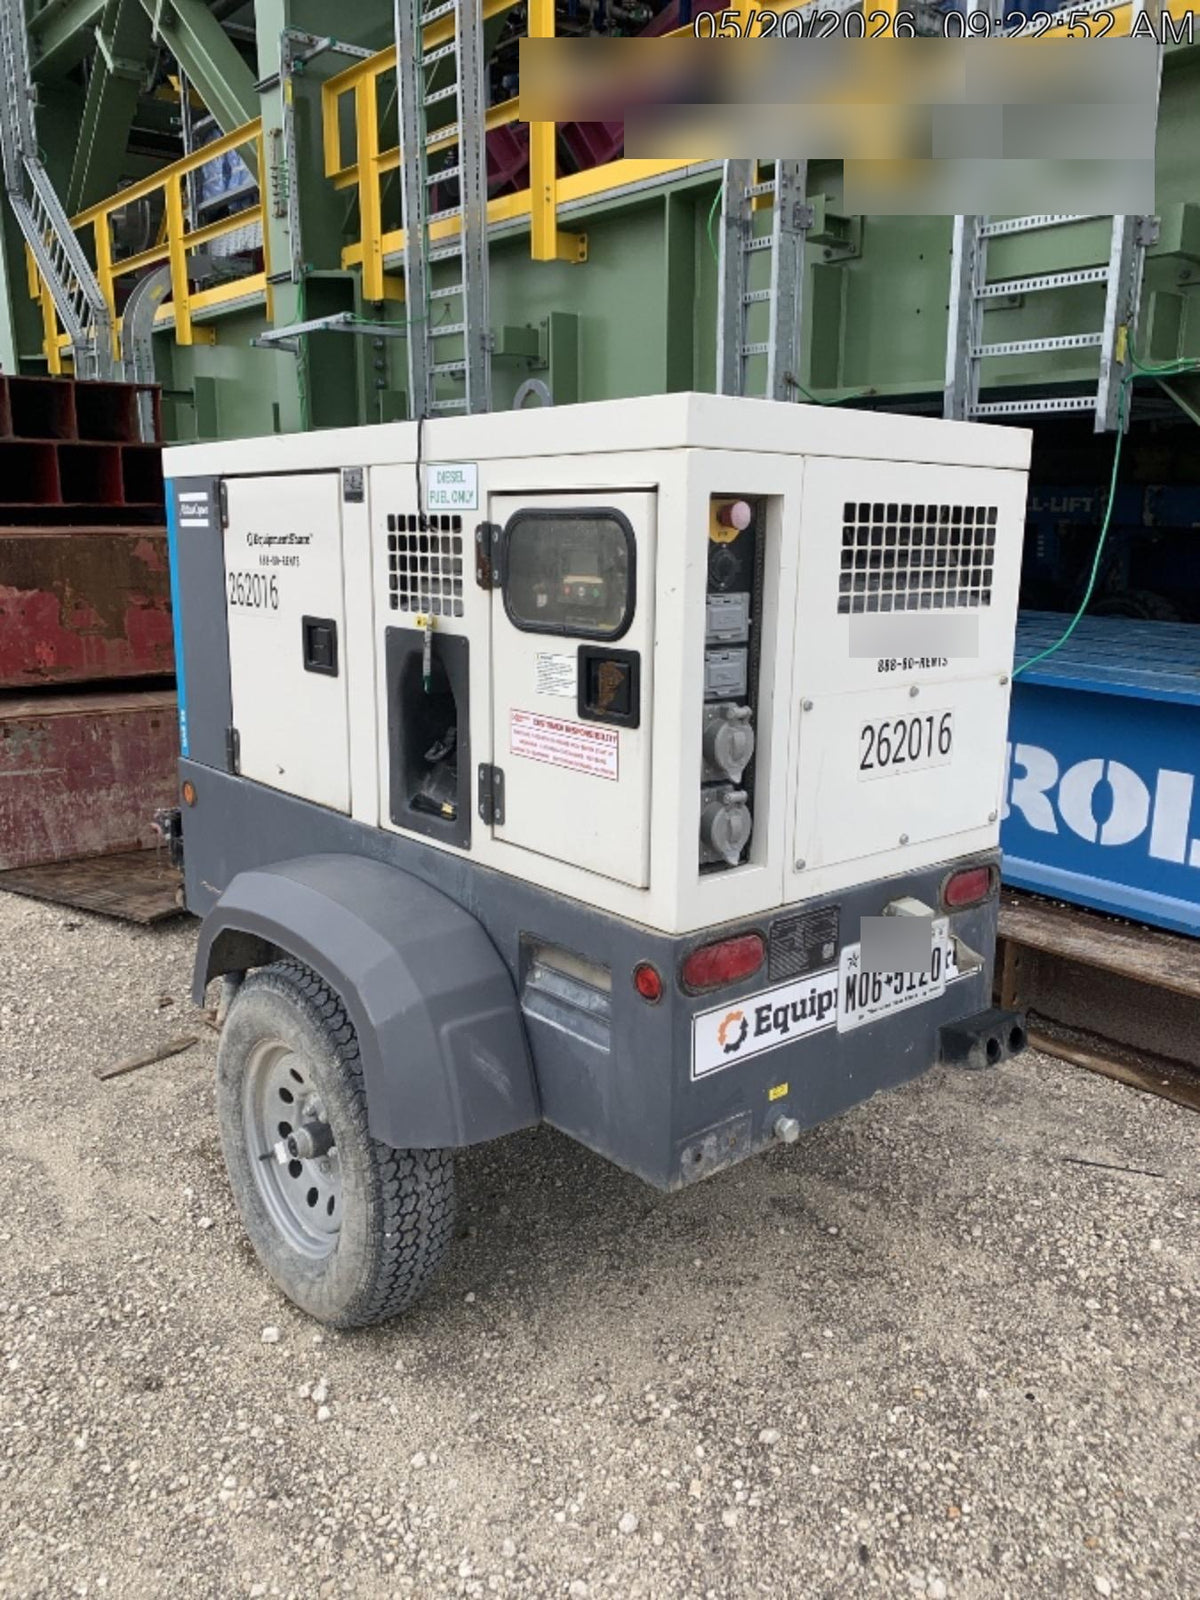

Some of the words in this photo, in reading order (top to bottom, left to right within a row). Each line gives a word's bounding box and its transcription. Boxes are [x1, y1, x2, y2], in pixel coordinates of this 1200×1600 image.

[437, 470, 466, 484] DIESEL
[430, 490, 451, 504] FUEL
[452, 490, 474, 504] ONLY
[1028, 496, 1094, 513] L-LIFT
[228, 572, 279, 610] 262016
[860, 712, 952, 770] 262016
[753, 988, 838, 1037] Equip
